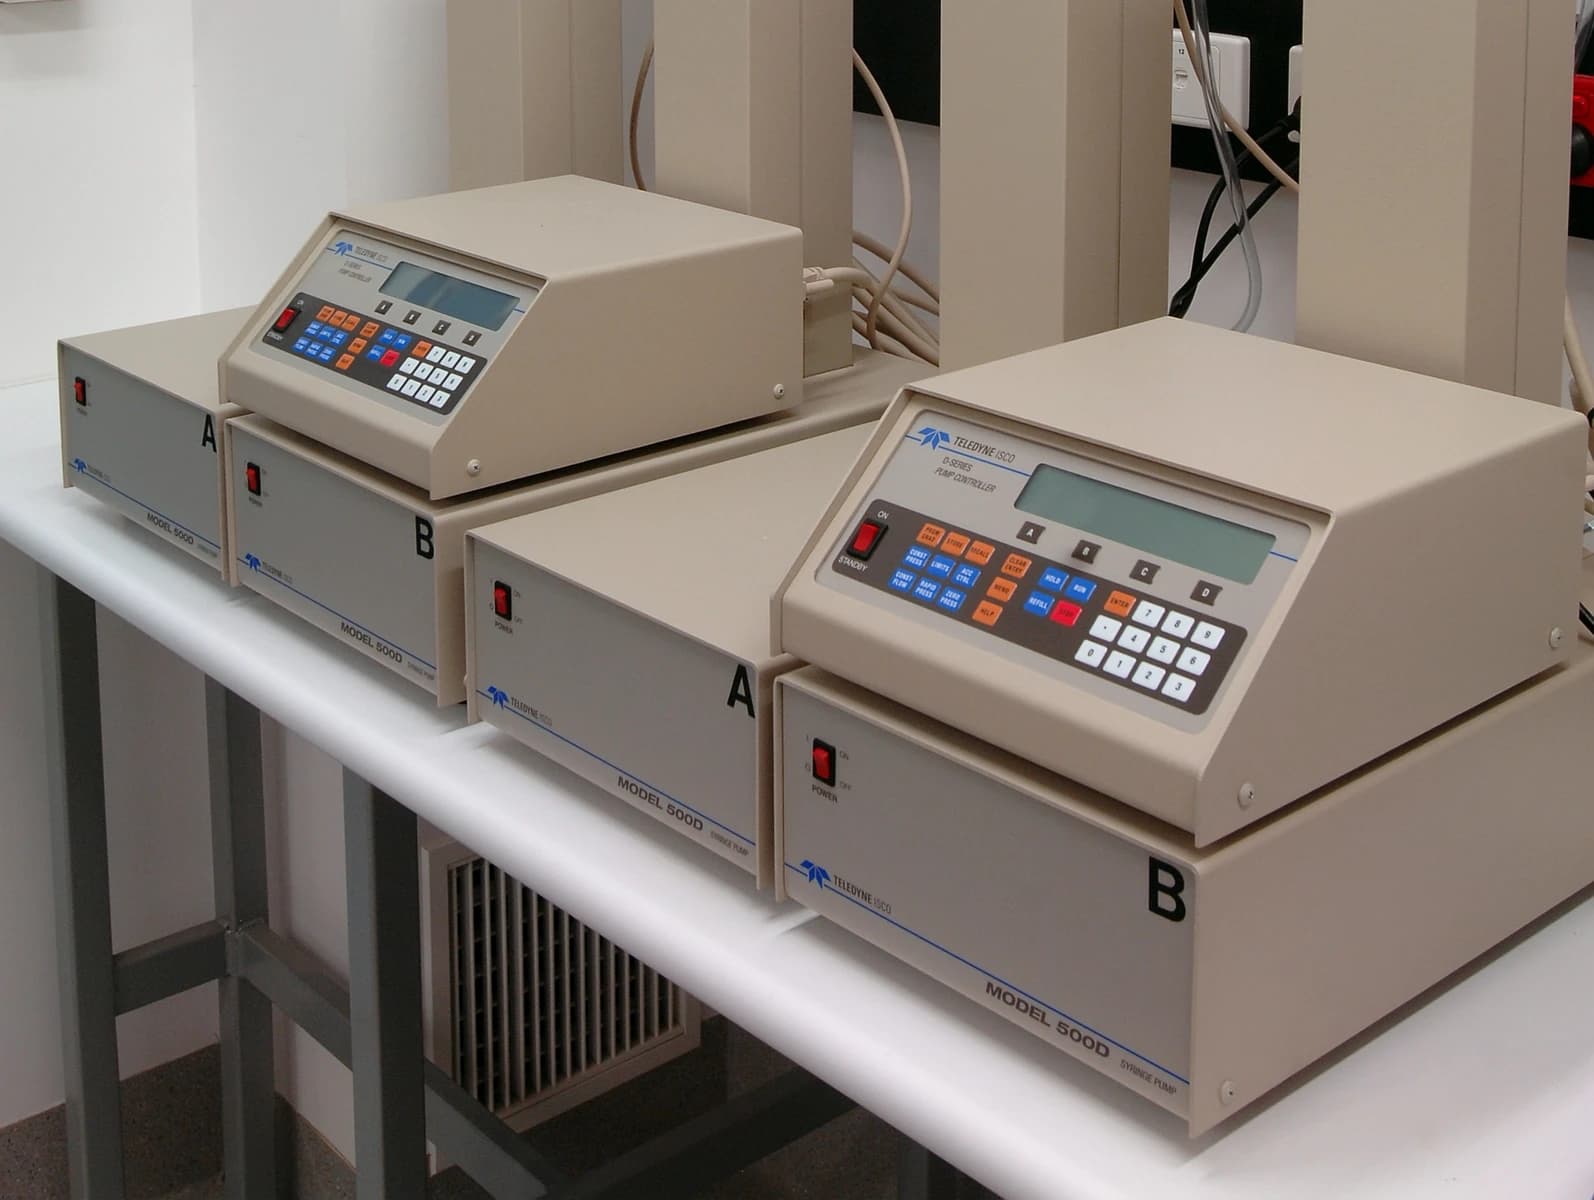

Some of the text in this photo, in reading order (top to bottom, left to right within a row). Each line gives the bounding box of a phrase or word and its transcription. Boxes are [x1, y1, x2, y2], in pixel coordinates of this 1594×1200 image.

[202, 413, 217, 452] A
[954, 436, 1015, 463] TELEDYNE ISCO
[942, 456, 973, 472] D-SERIES
[954, 474, 996, 492] CONTROLLER
[147, 513, 172, 533] MODEL
[877, 511, 889, 520] ON
[415, 515, 434, 560] B
[1026, 528, 1034, 538] A
[838, 555, 868, 572] STANDBY
[1141, 567, 1149, 577] C
[1110, 597, 1130, 608] ENTER
[1202, 588, 1210, 598] D
[1145, 609, 1152, 617] 7
[341, 622, 402, 663] MODEL 500D
[1131, 634, 1197, 665] 4 5 6
[726, 663, 756, 719] A
[1145, 671, 1152, 680] 2
[1175, 683, 1182, 692] 3
[618, 775, 663, 810] MODEL
[667, 804, 703, 831] 500D
[812, 784, 838, 804] POWER
[833, 874, 872, 905] TELEDYNE
[1148, 856, 1186, 922] B
[986, 981, 1177, 1094] MODEL 500D SYRINGE PUMP
